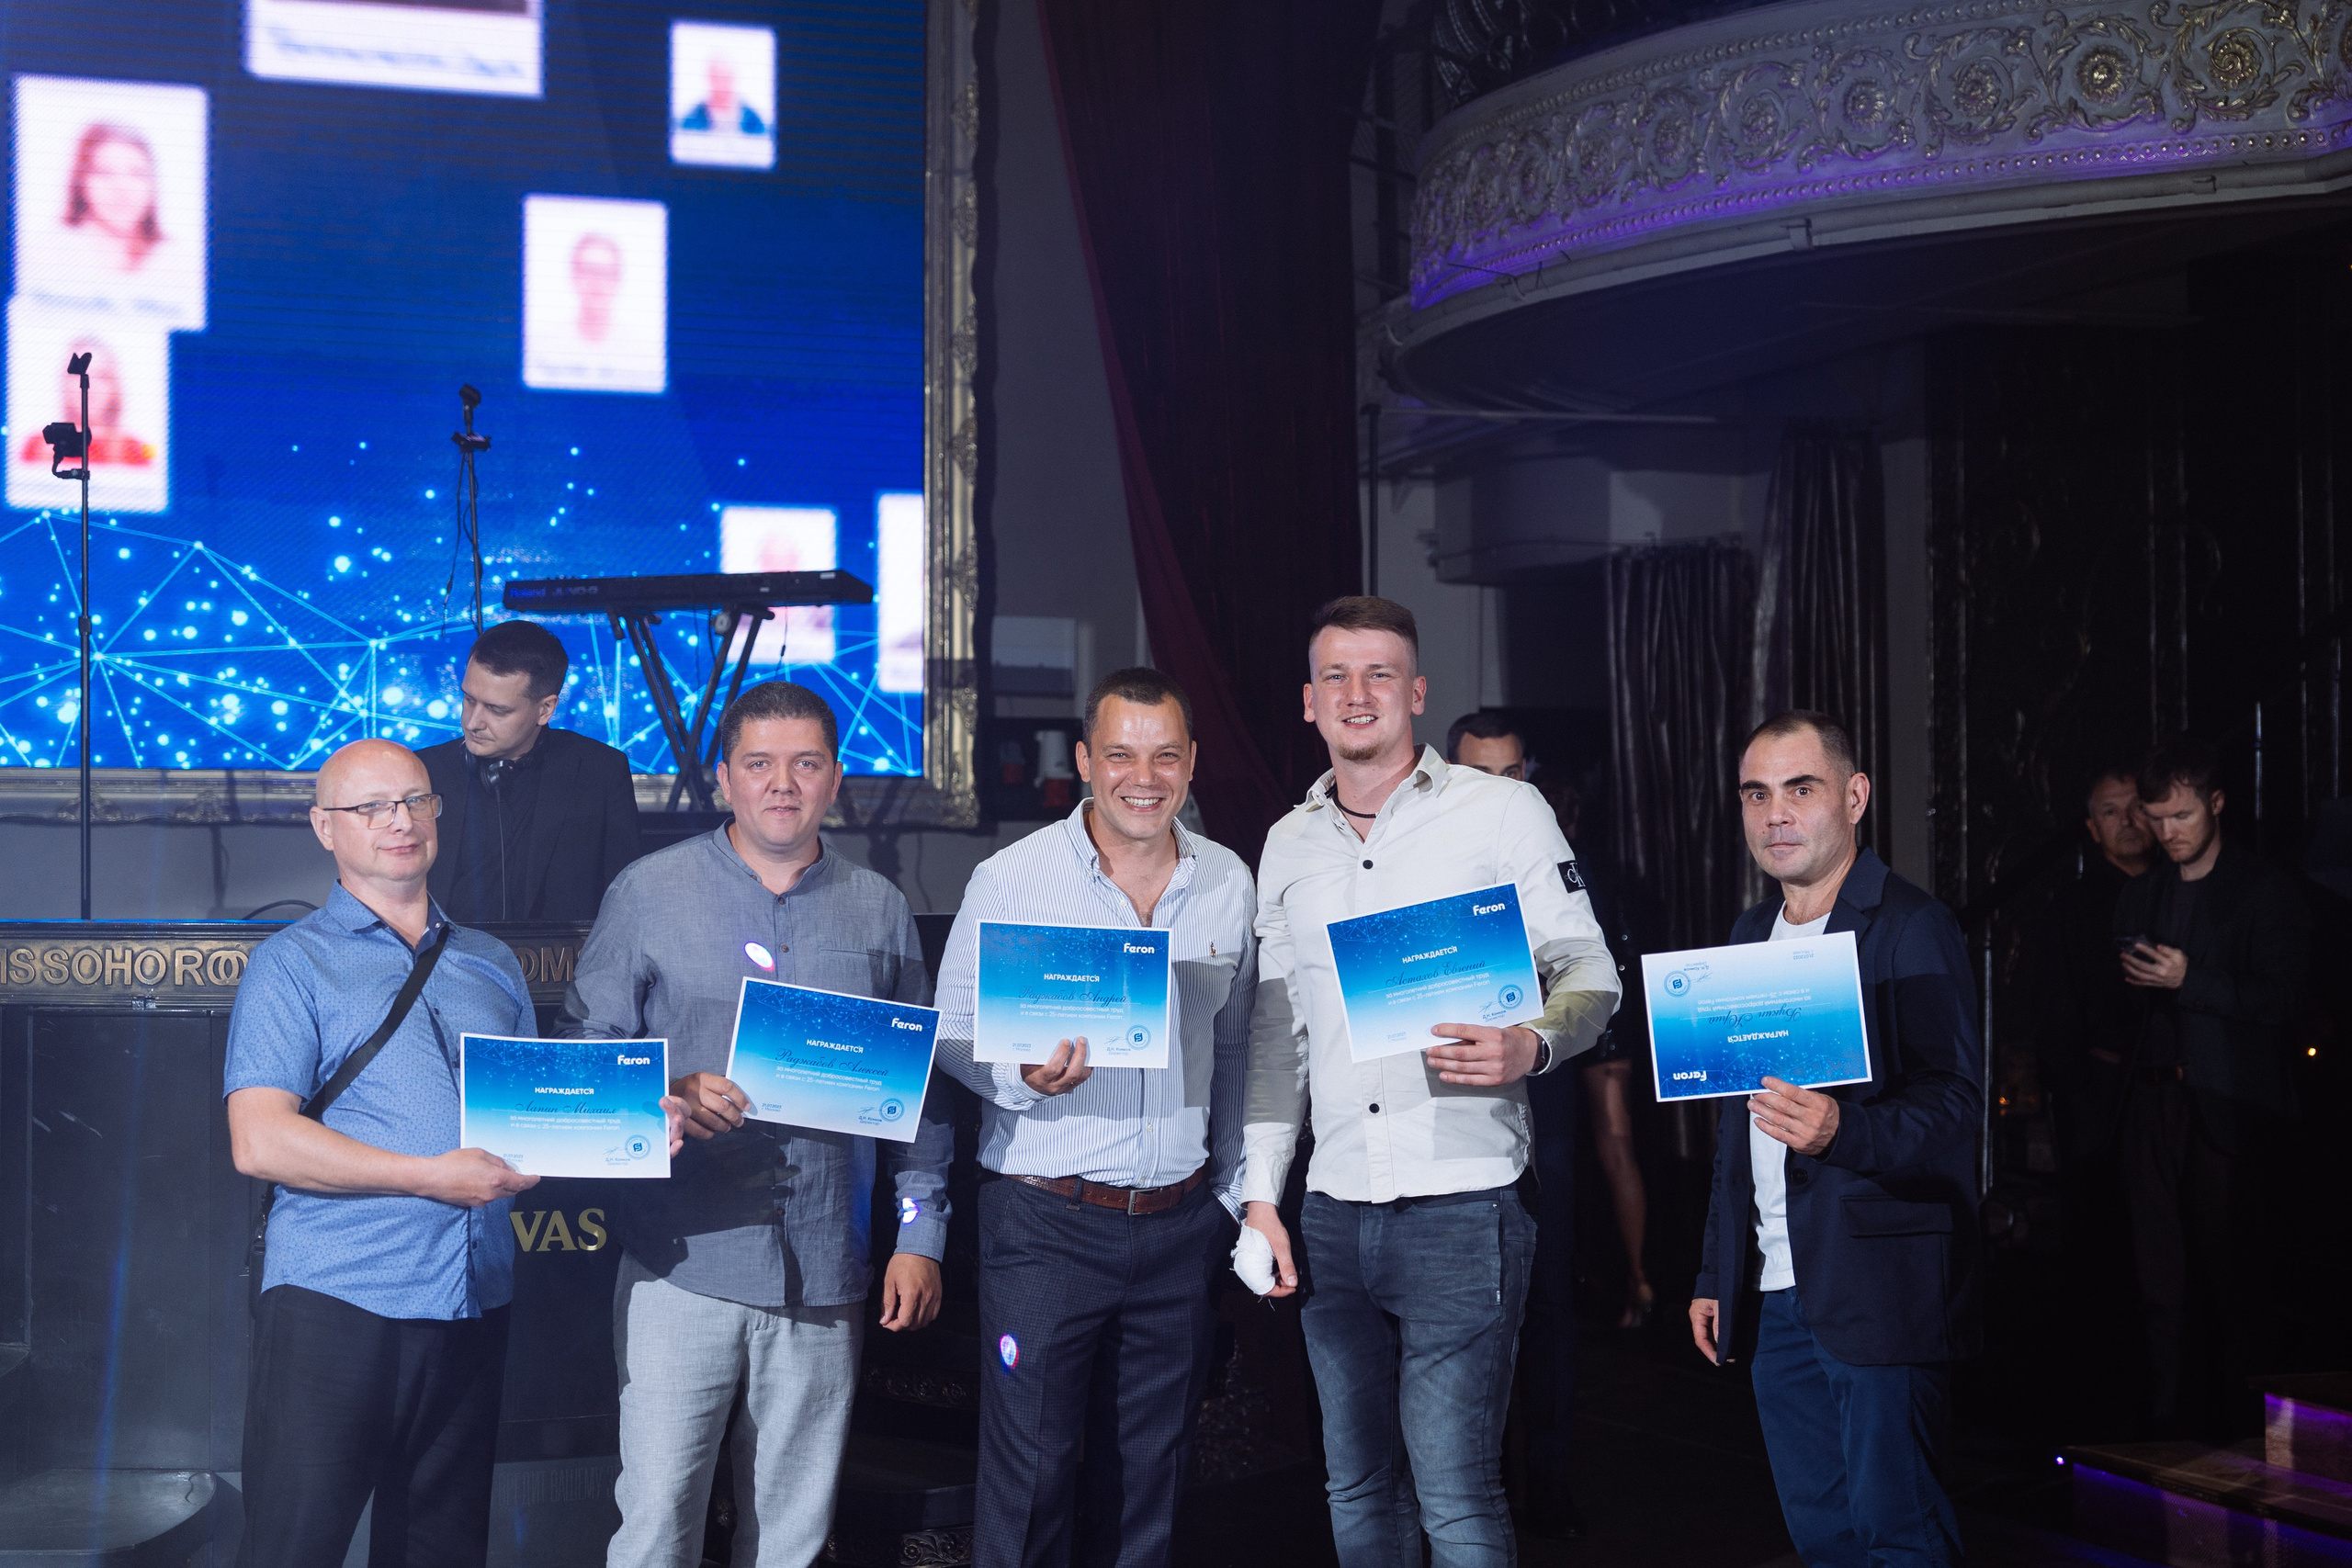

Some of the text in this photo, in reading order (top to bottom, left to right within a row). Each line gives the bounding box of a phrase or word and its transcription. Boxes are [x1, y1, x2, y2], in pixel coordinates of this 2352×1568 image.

[1473, 902, 1506, 916] Feron
[1124, 942, 1155, 954] Feron
[1402, 946, 1458, 964] НАГРАЖДАЕТСЯ
[43, 949, 166, 986] SOHO
[1385, 959, 1486, 987] Астахов Евгений
[1044, 974, 1100, 983] НАГРАЖДАЕТСЯ
[1393, 986, 1428, 998] многолетний
[1427, 975, 1476, 990] добросовестный
[1476, 971, 1489, 980] труд
[1473, 978, 1490, 987] Feron
[1018, 985, 1128, 1008] Раджабов Андрей
[1764, 997, 1804, 1005] многолетний
[1712, 1000, 1764, 1011] добросовестный
[1708, 1002, 1803, 1029] Букин Юрий
[890, 1017, 923, 1032] Feron
[1727, 1029, 1789, 1043] НАГРАЖДАЕТСЯ
[806, 1039, 864, 1054] НАГРАЖДАЕТСЯ
[617, 1055, 650, 1066] Feron
[775, 1048, 889, 1077] Раджабов Алексей
[784, 1067, 820, 1077] многолетний
[820, 1073, 868, 1084] добросовестный
[1673, 1070, 1707, 1081] Feron
[535, 1087, 594, 1096] НАГРАЖДАЕТСЯ
[514, 1100, 616, 1114] Лапин Михаил
[509, 1208, 607, 1252] VAS
